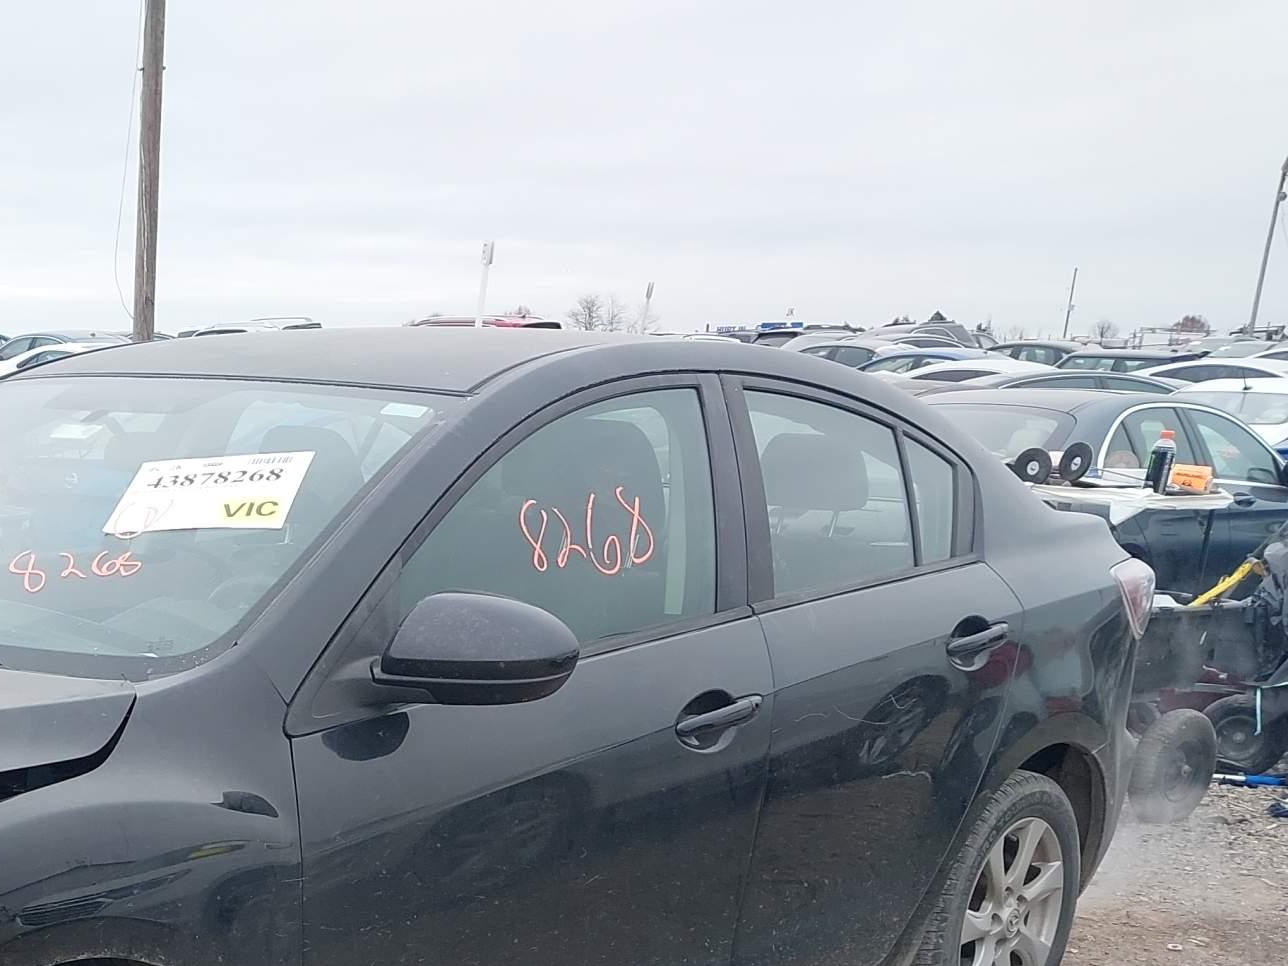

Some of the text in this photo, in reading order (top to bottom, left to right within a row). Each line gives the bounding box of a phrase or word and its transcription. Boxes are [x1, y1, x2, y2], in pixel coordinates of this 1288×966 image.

[147, 468, 284, 489] 43878268
[223, 500, 279, 518] VIC
[519, 486, 654, 575] 8268
